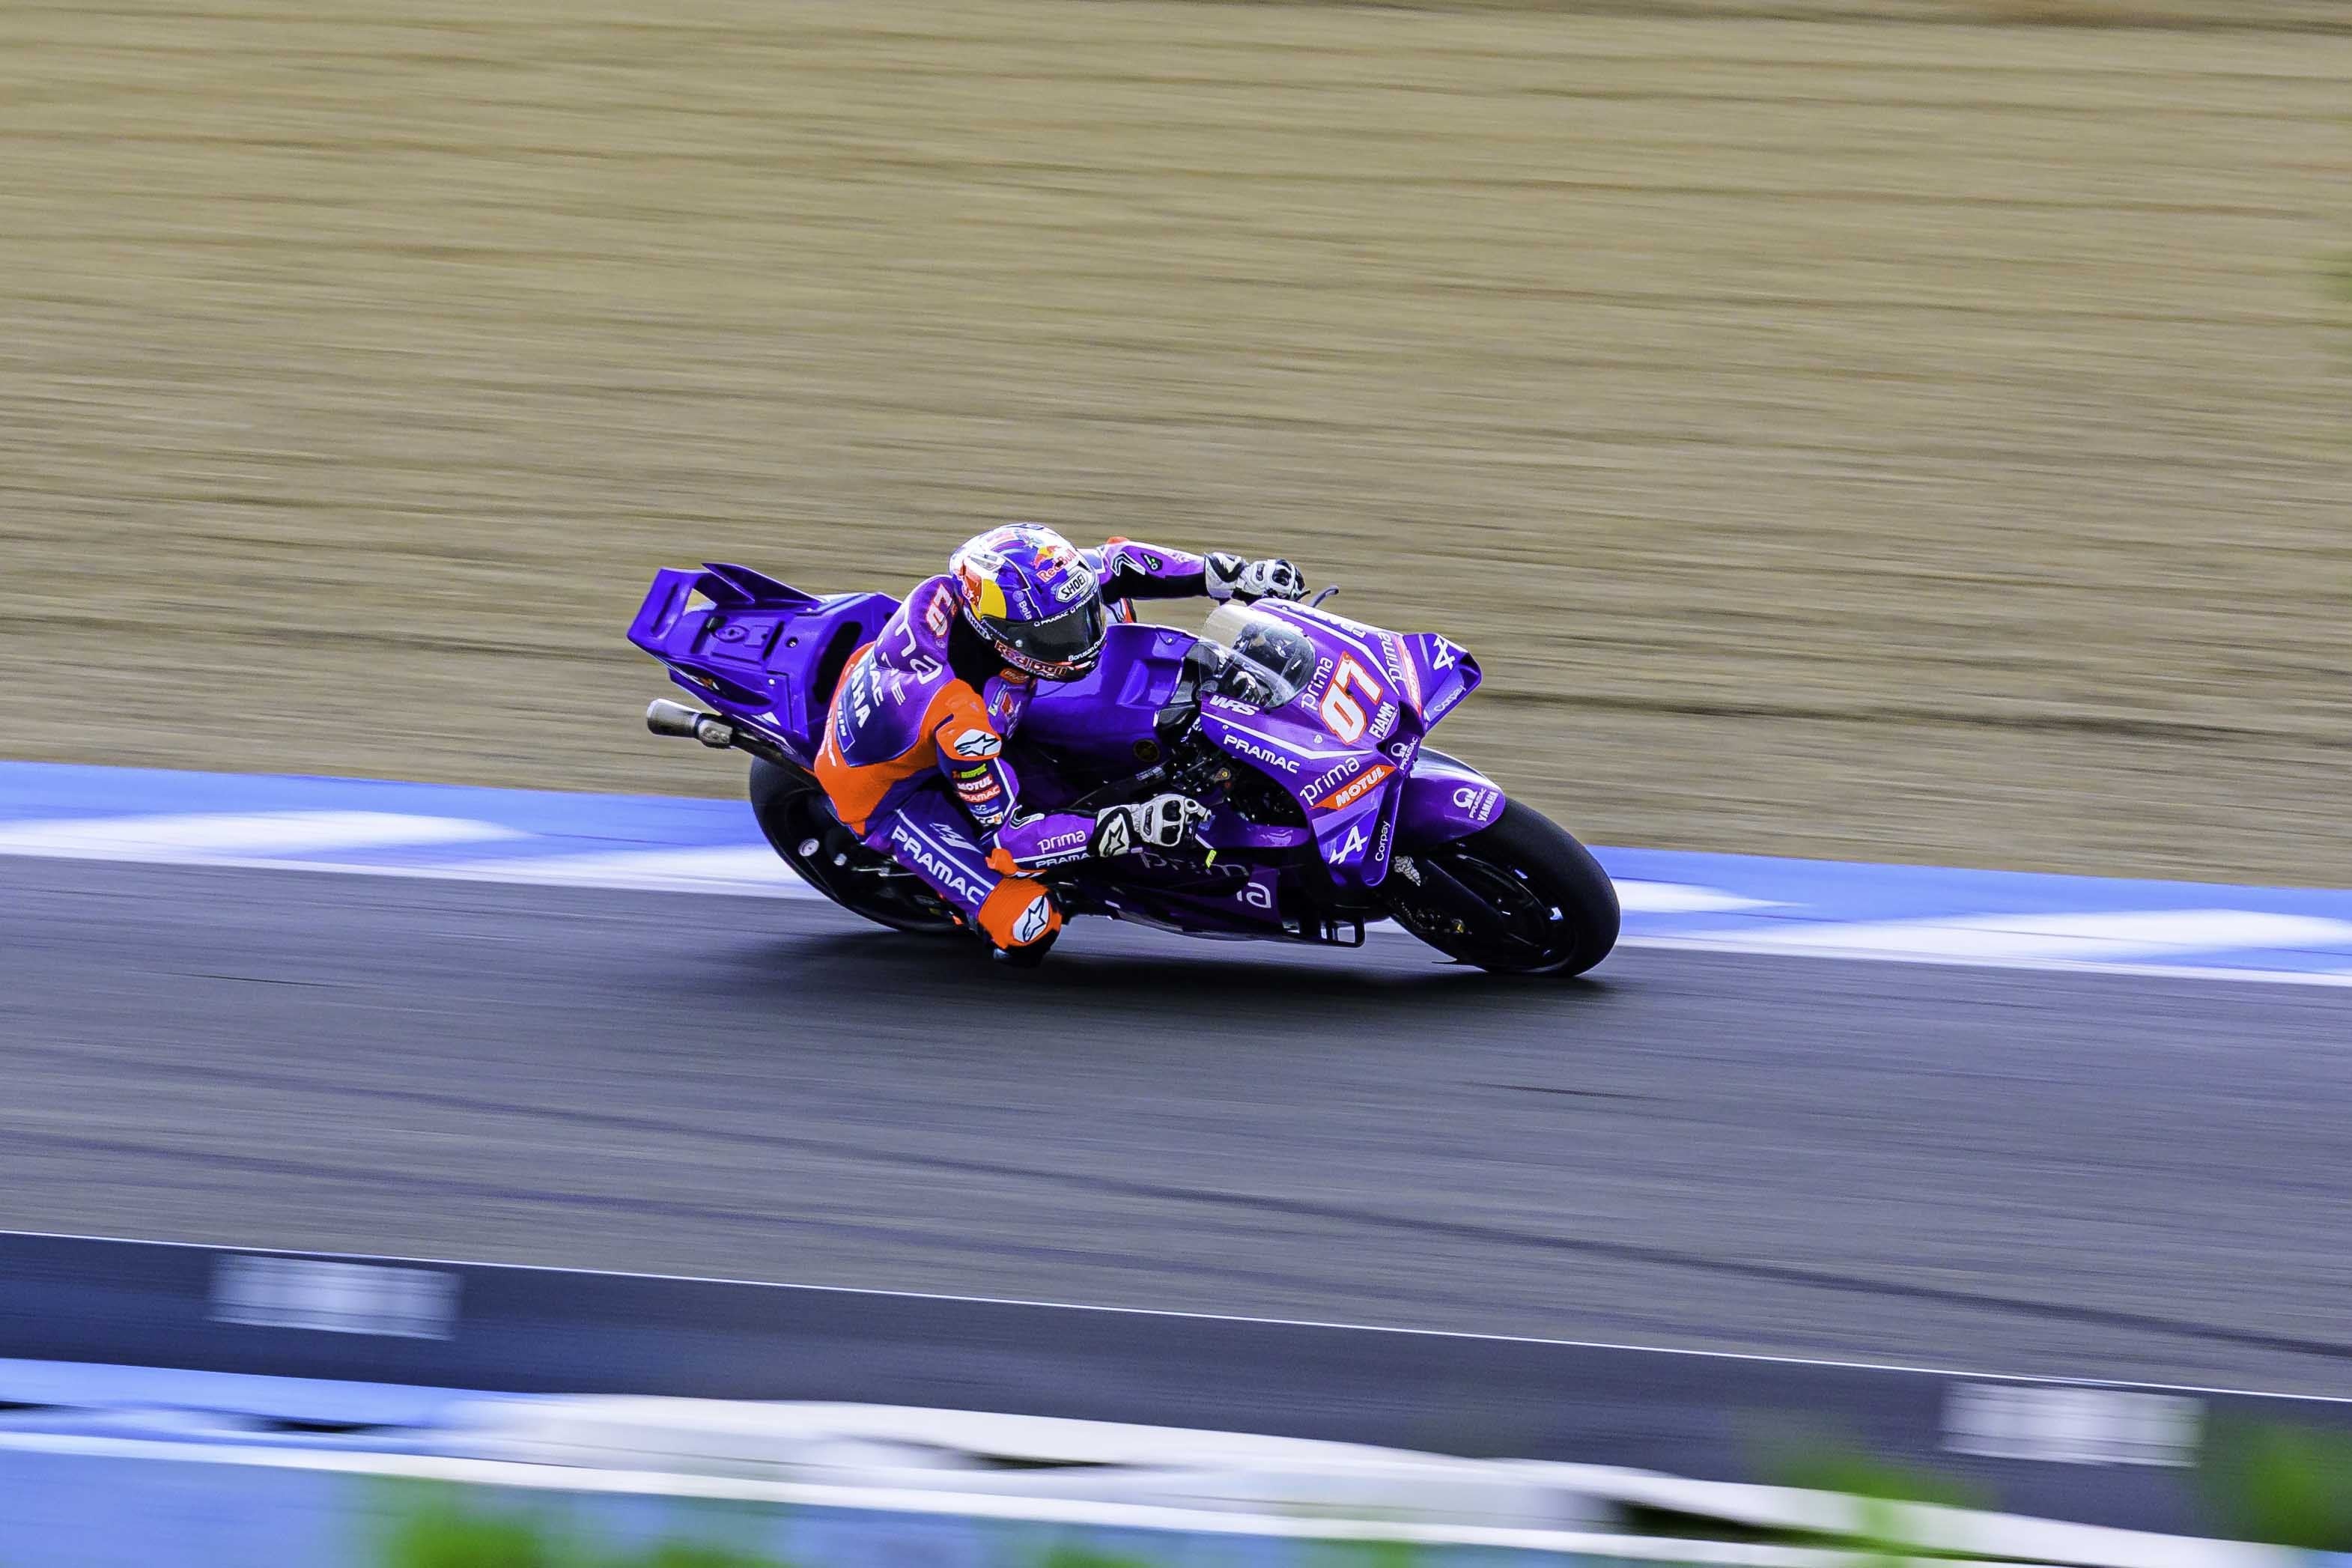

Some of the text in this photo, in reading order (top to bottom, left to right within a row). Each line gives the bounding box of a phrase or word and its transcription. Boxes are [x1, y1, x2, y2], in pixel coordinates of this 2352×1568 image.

[1061, 574, 1087, 598] SHOEI
[1041, 611, 1069, 625] PRAMAC
[1377, 631, 1406, 684] prima
[1301, 657, 1334, 711] prima
[1319, 651, 1384, 745] 07
[1209, 694, 1260, 717] WRS
[1369, 701, 1397, 739] FIAMM
[1223, 734, 1301, 774] PRAMAC
[1399, 736, 1419, 771] PRAMAC
[1299, 756, 1361, 806] prima
[1335, 766, 1385, 808] MOTUL
[1477, 791, 1499, 822] YAMAHA
[1035, 852, 1091, 869] PRAMA
[1037, 830, 1087, 854] prima
[1375, 820, 1391, 862] Corpay
[891, 825, 985, 905] PRAMAC
